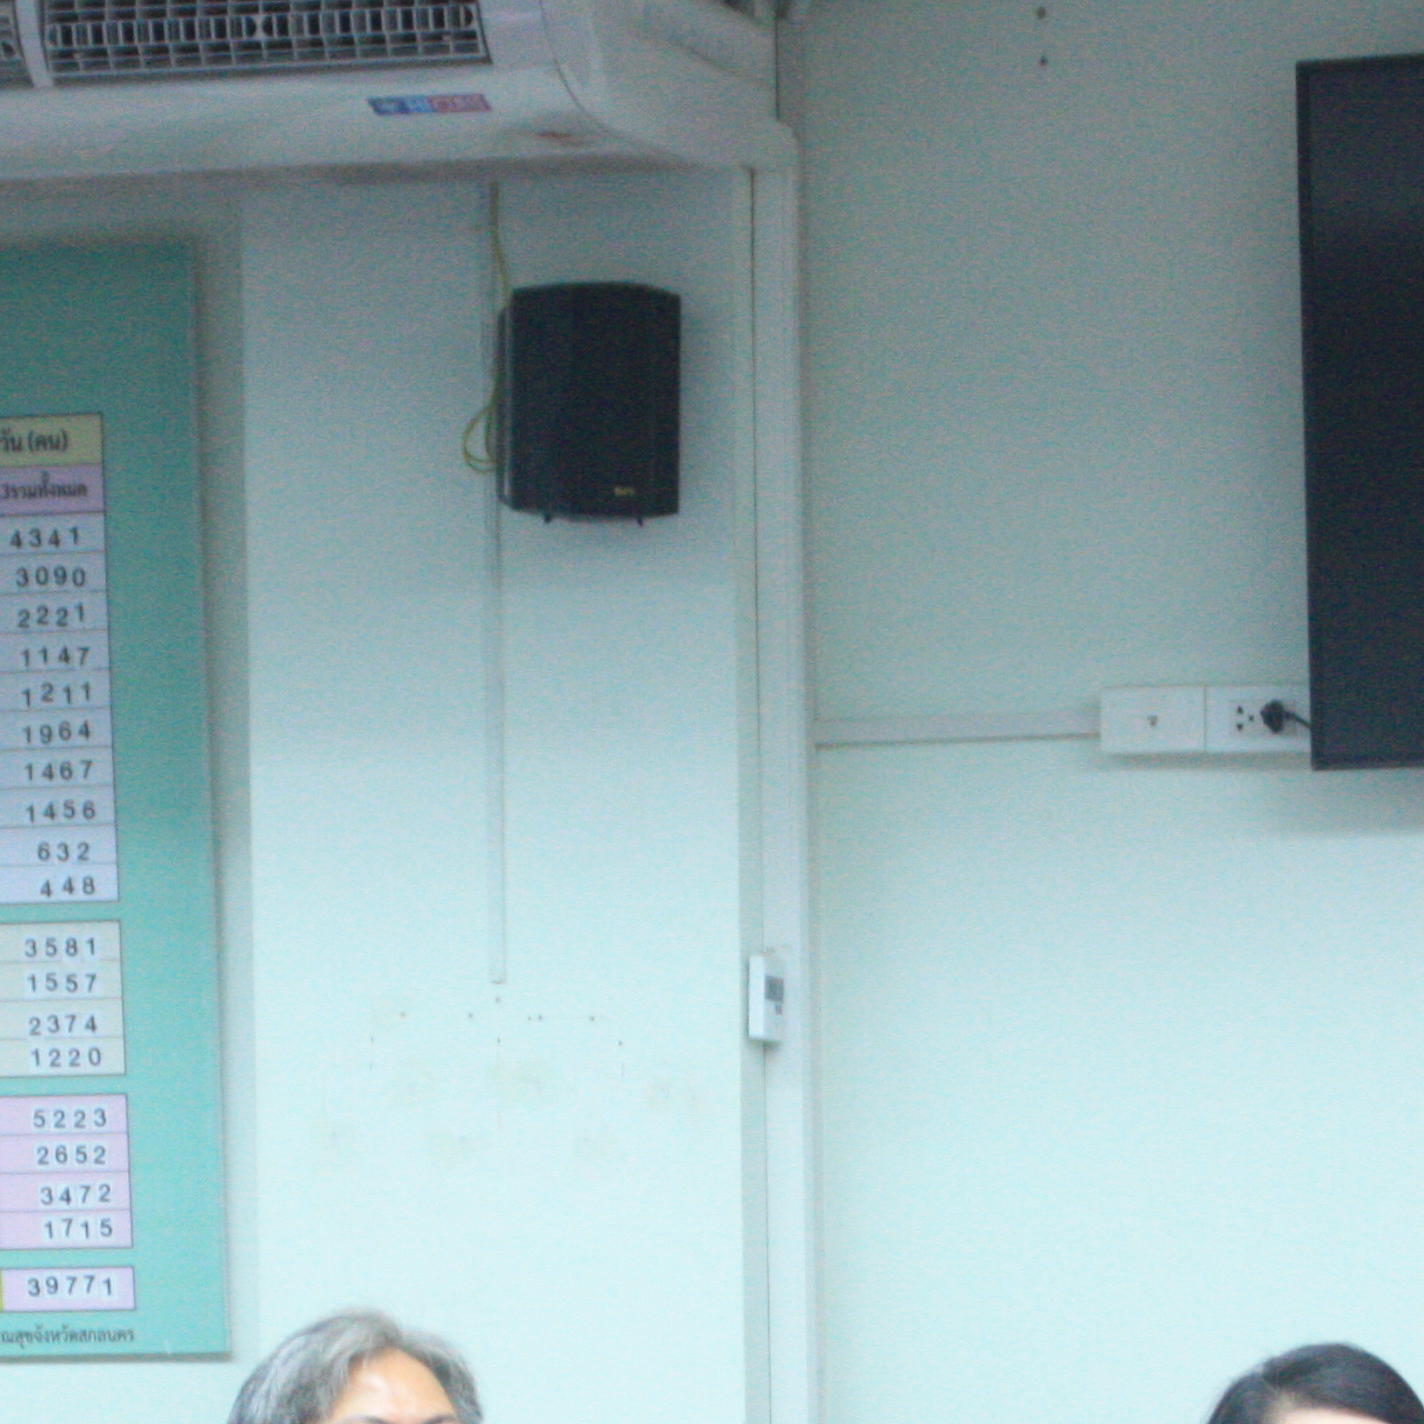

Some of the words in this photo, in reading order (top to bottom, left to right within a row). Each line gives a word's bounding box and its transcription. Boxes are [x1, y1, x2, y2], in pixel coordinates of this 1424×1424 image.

[9, 526, 81, 548] 4341
[16, 567, 86, 587] 3090
[18, 603, 86, 627] 2221
[23, 647, 89, 667] 1147
[23, 683, 91, 707] 1211
[23, 722, 91, 744] 1964
[24, 760, 92, 781] 1467
[26, 801, 96, 823] 1456
[38, 843, 90, 861] 632
[40, 876, 95, 897] 448
[25, 938, 96, 957] 3581
[27, 974, 97, 992] 1557
[29, 1015, 97, 1036] 2374
[32, 1049, 101, 1068] 1220
[34, 1108, 106, 1129] 5223
[37, 1146, 106, 1165] 2652
[40, 1184, 111, 1205] 3472
[43, 1218, 113, 1239] 1715
[28, 1274, 113, 1296] 39771
